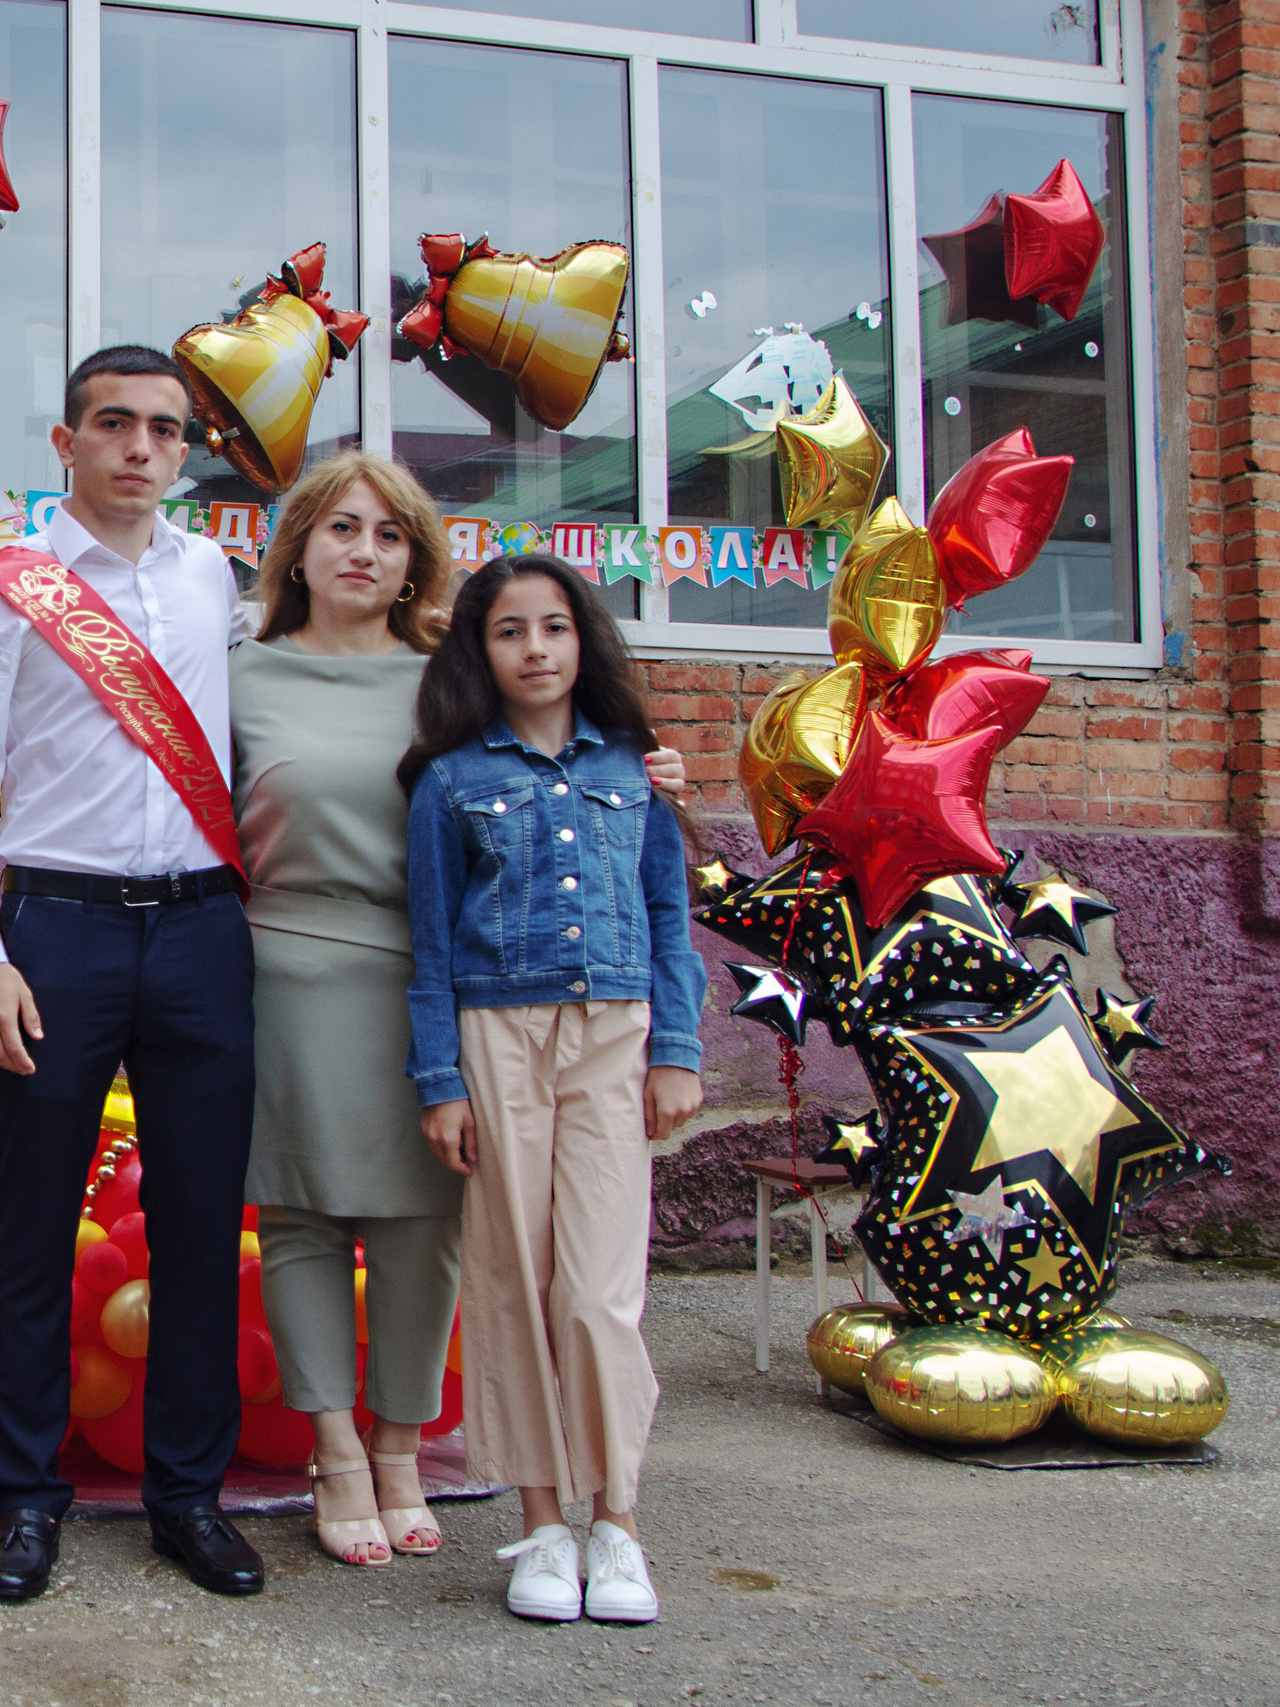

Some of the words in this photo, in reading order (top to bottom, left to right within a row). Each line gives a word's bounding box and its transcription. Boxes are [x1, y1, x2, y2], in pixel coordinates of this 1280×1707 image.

[554, 528, 837, 575] ШКОЛА!
[6, 582, 31, 600] МБОУ
[27, 600, 44, 611] СШ
[62, 610, 202, 769] Выпускник
[176, 765, 235, 830] 2021
[114, 699, 155, 746] Республика
